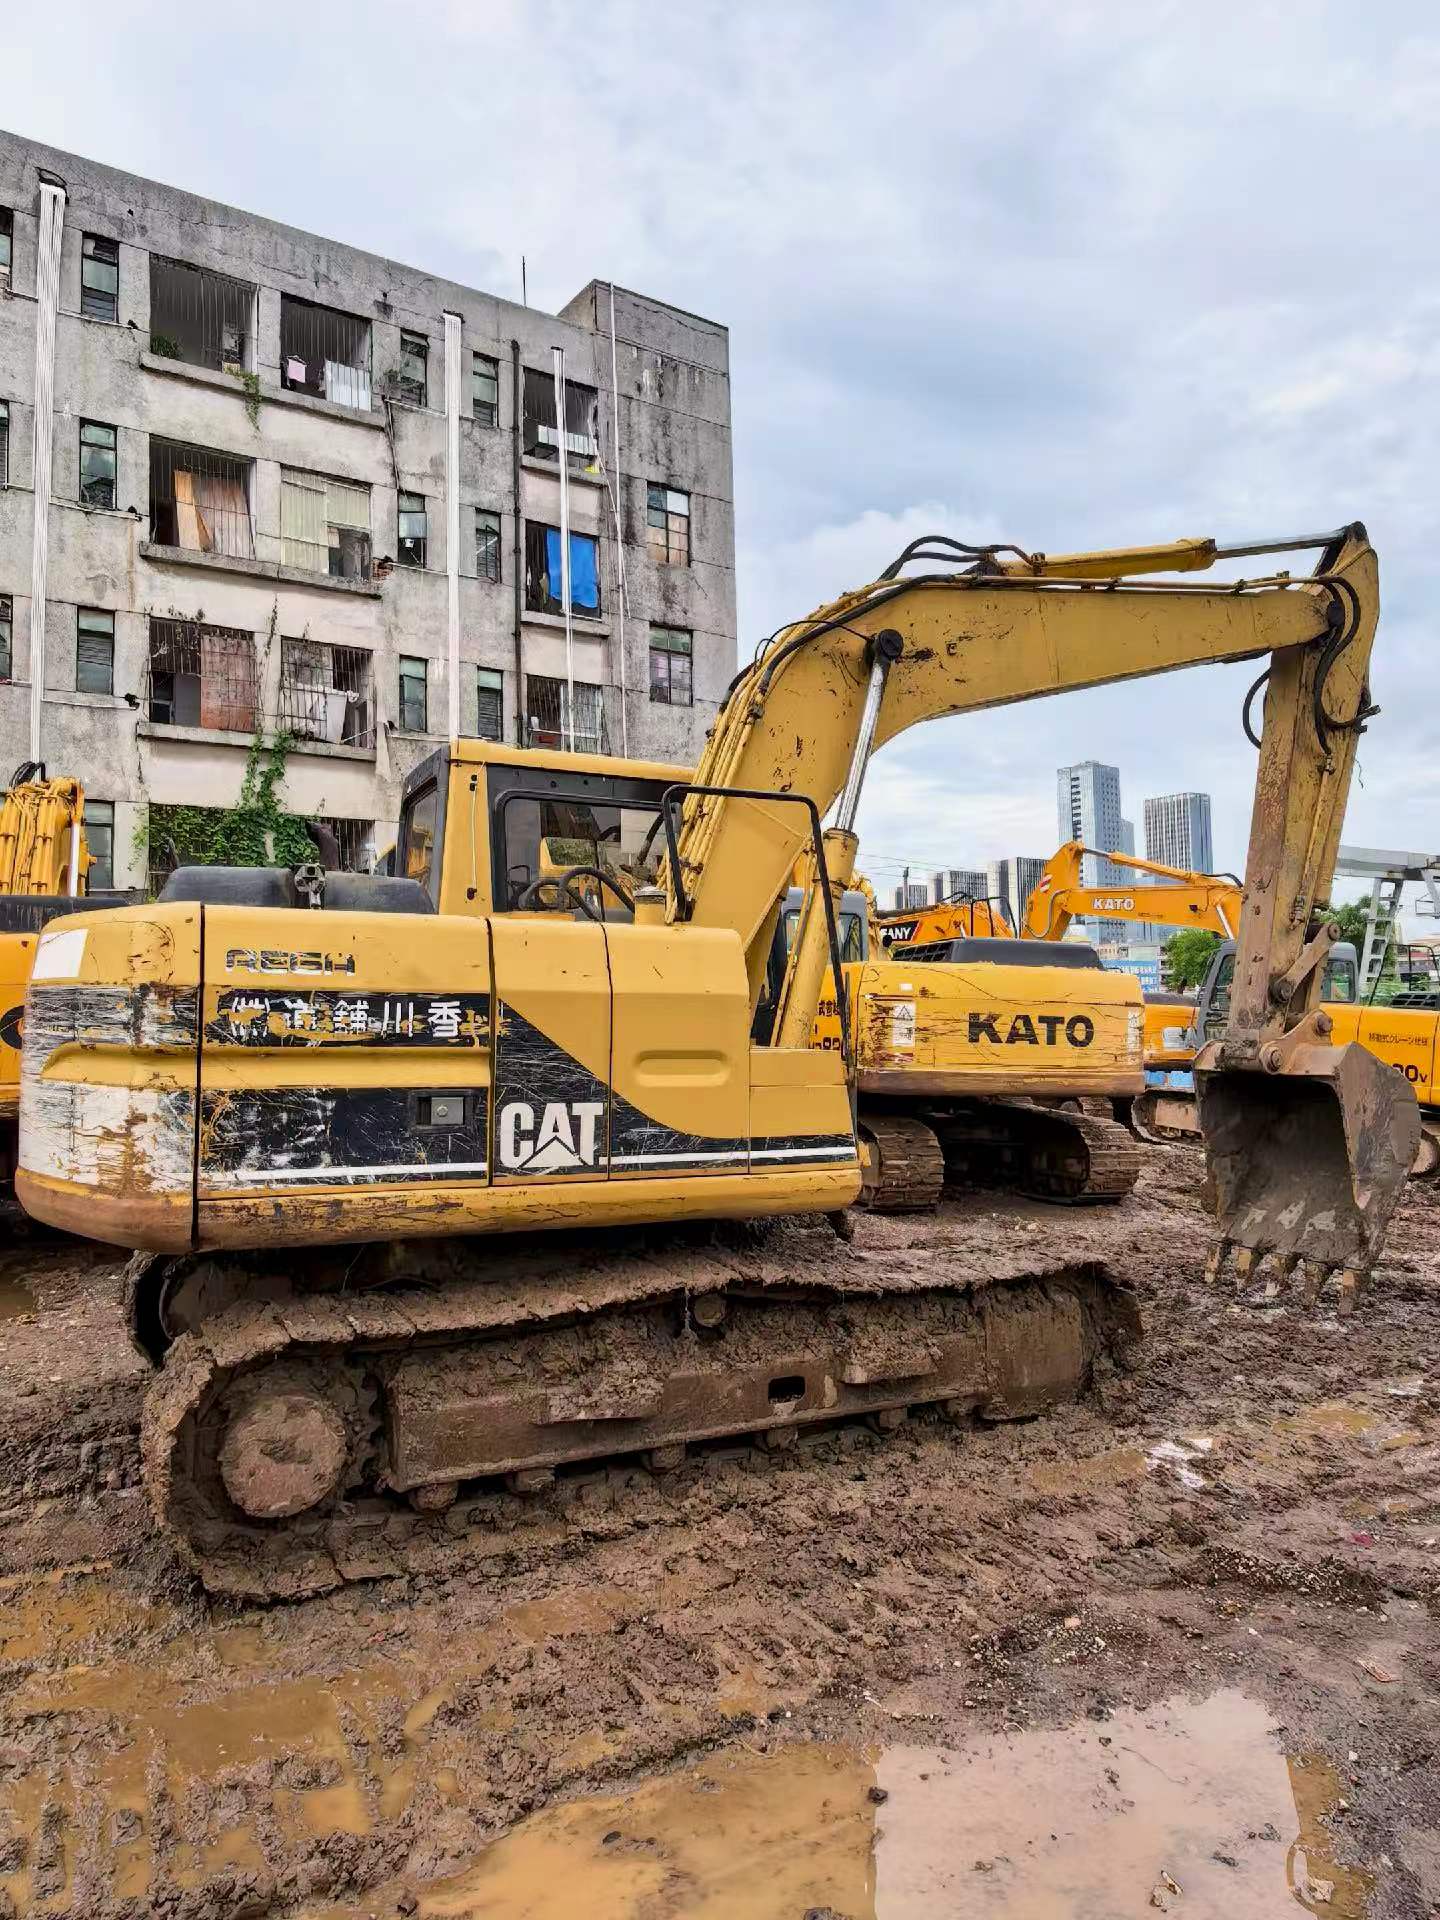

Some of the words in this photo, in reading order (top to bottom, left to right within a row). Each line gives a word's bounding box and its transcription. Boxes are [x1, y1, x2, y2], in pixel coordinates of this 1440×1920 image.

[1093, 897, 1136, 912] KATO
[968, 1012, 1095, 1048] KATO
[500, 1102, 604, 1168] CAT
